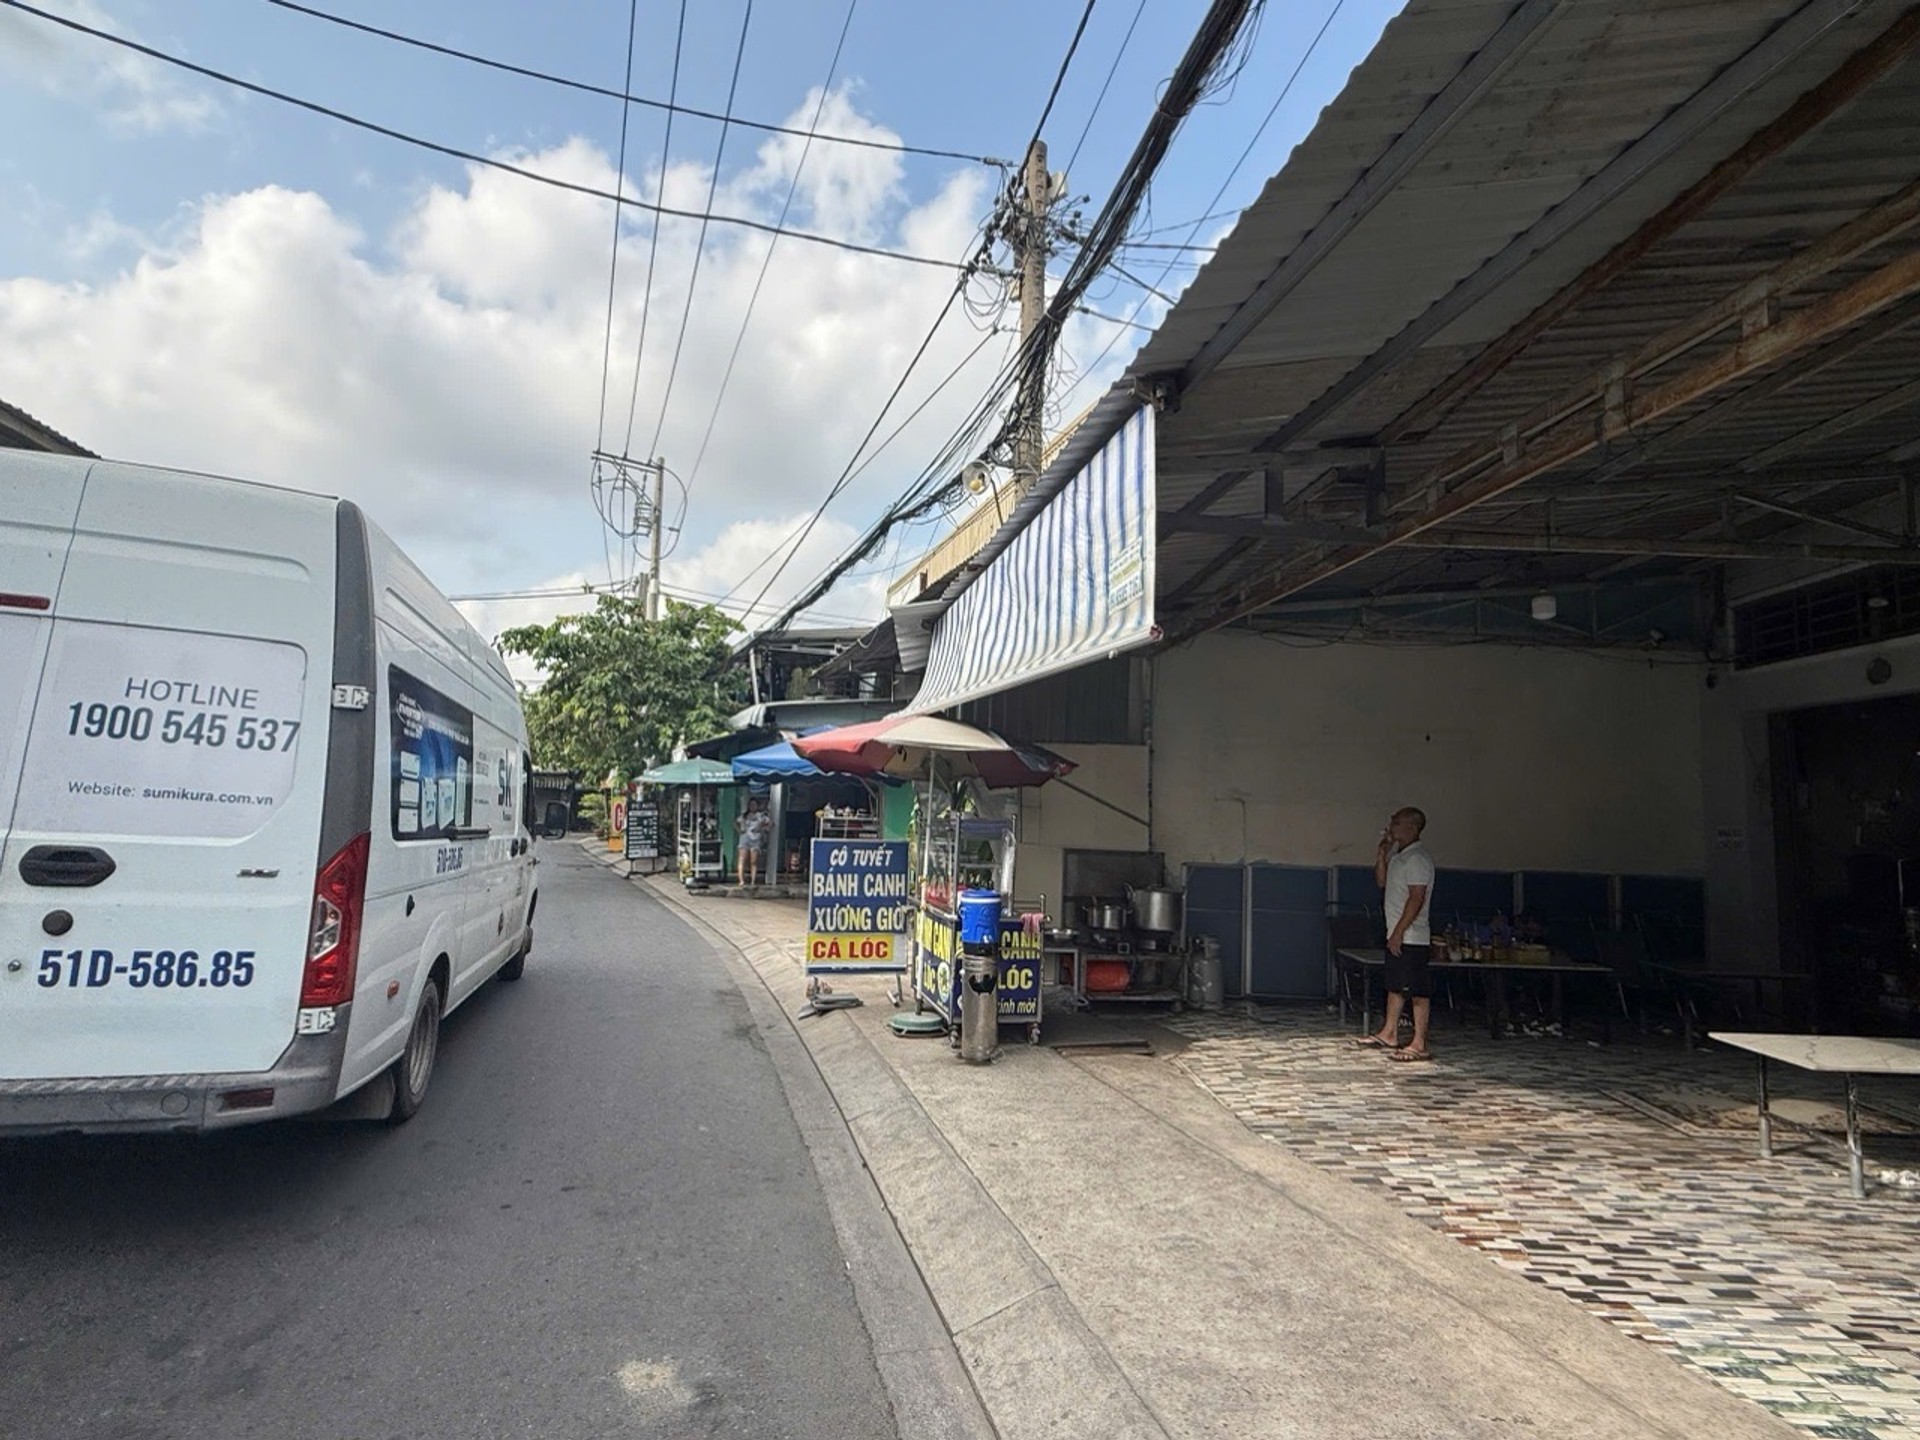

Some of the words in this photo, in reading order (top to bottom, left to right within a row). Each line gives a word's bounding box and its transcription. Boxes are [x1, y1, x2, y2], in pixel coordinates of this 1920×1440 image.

[125, 677, 259, 709] HOTLINE
[69, 702, 153, 741] 1900
[161, 709, 228, 747] 545
[236, 716, 301, 752] 537
[68, 781, 135, 798] Website:
[142, 787, 273, 806] sumikura.com.vn
[830, 845, 848, 866] CÔ
[853, 843, 893, 866] TUYẾT
[813, 867, 858, 897] BÁNH
[863, 873, 906, 897] CANH
[813, 903, 872, 931] XƯƠNG
[813, 937, 841, 958] CÁ
[849, 937, 888, 959] LÓC
[37, 949, 256, 988] 51D-586.85
